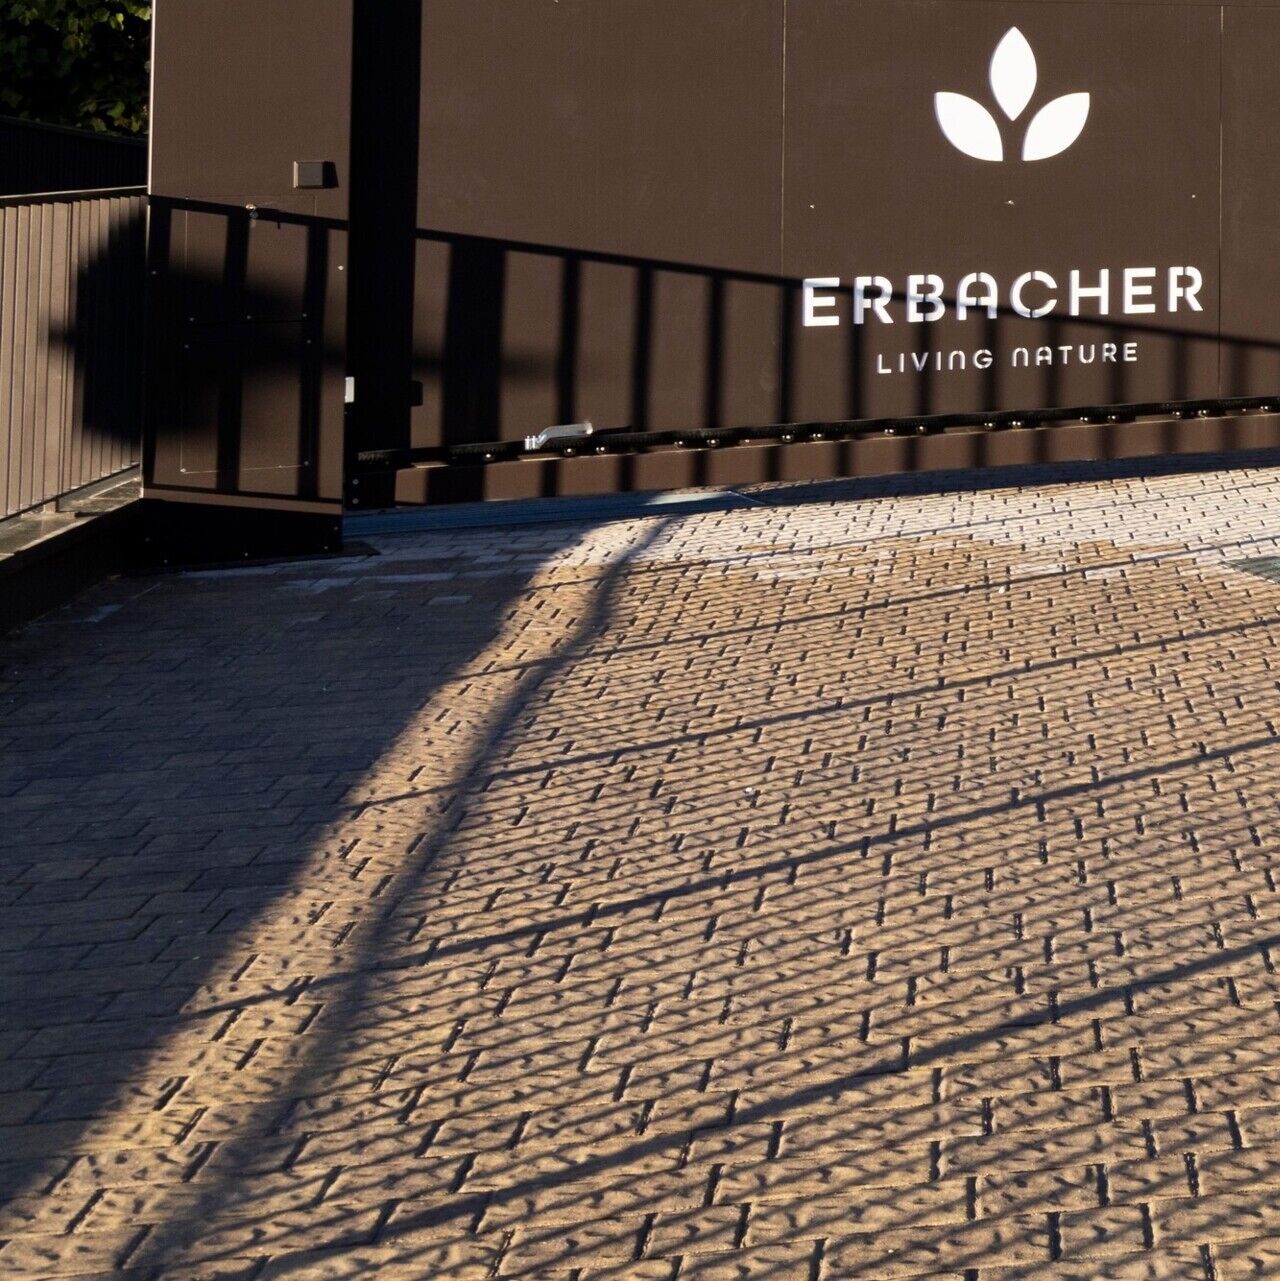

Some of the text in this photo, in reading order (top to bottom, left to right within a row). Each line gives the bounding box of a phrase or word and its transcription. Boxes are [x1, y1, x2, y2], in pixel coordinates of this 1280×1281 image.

[802, 265, 1204, 327] ERBACHER
[876, 342, 1138, 375] LIVING NATURE
